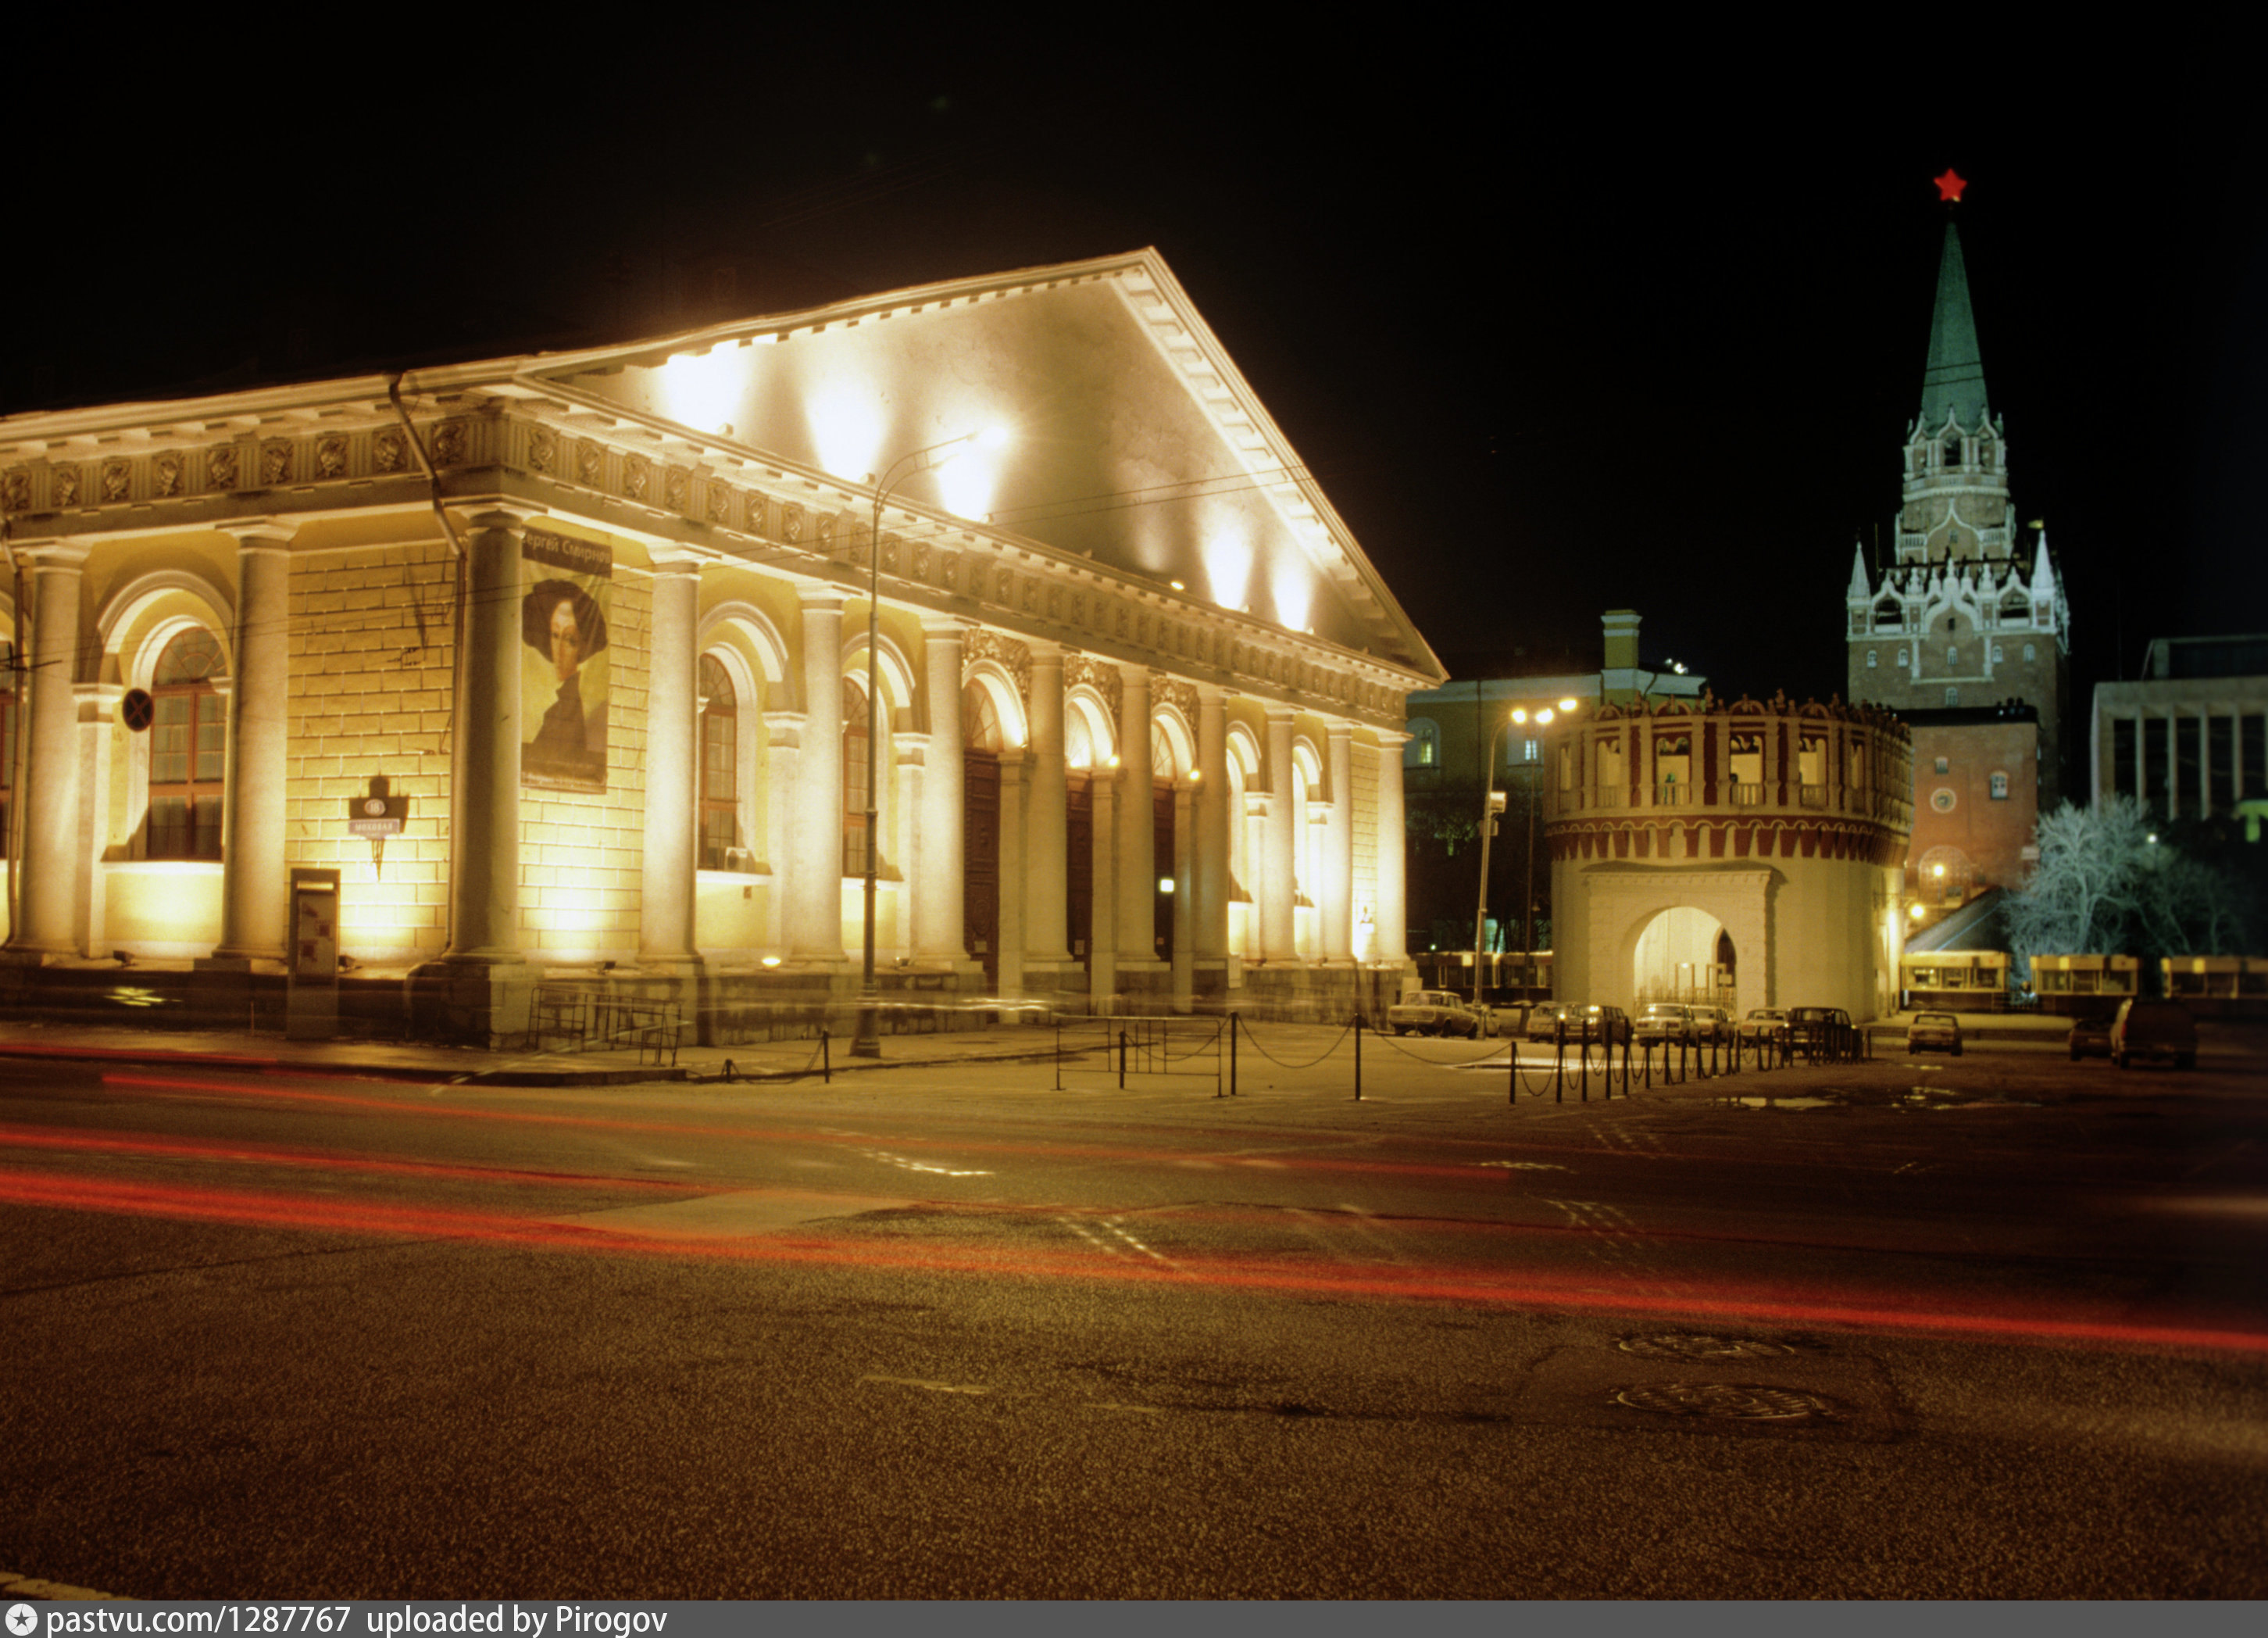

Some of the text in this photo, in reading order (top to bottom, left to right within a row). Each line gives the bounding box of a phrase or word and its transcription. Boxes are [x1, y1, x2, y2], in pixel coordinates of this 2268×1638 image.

[562, 540, 611, 563] Смирнов
[370, 803, 380, 814] 18
[355, 823, 393, 832] МОХОВАЯ
